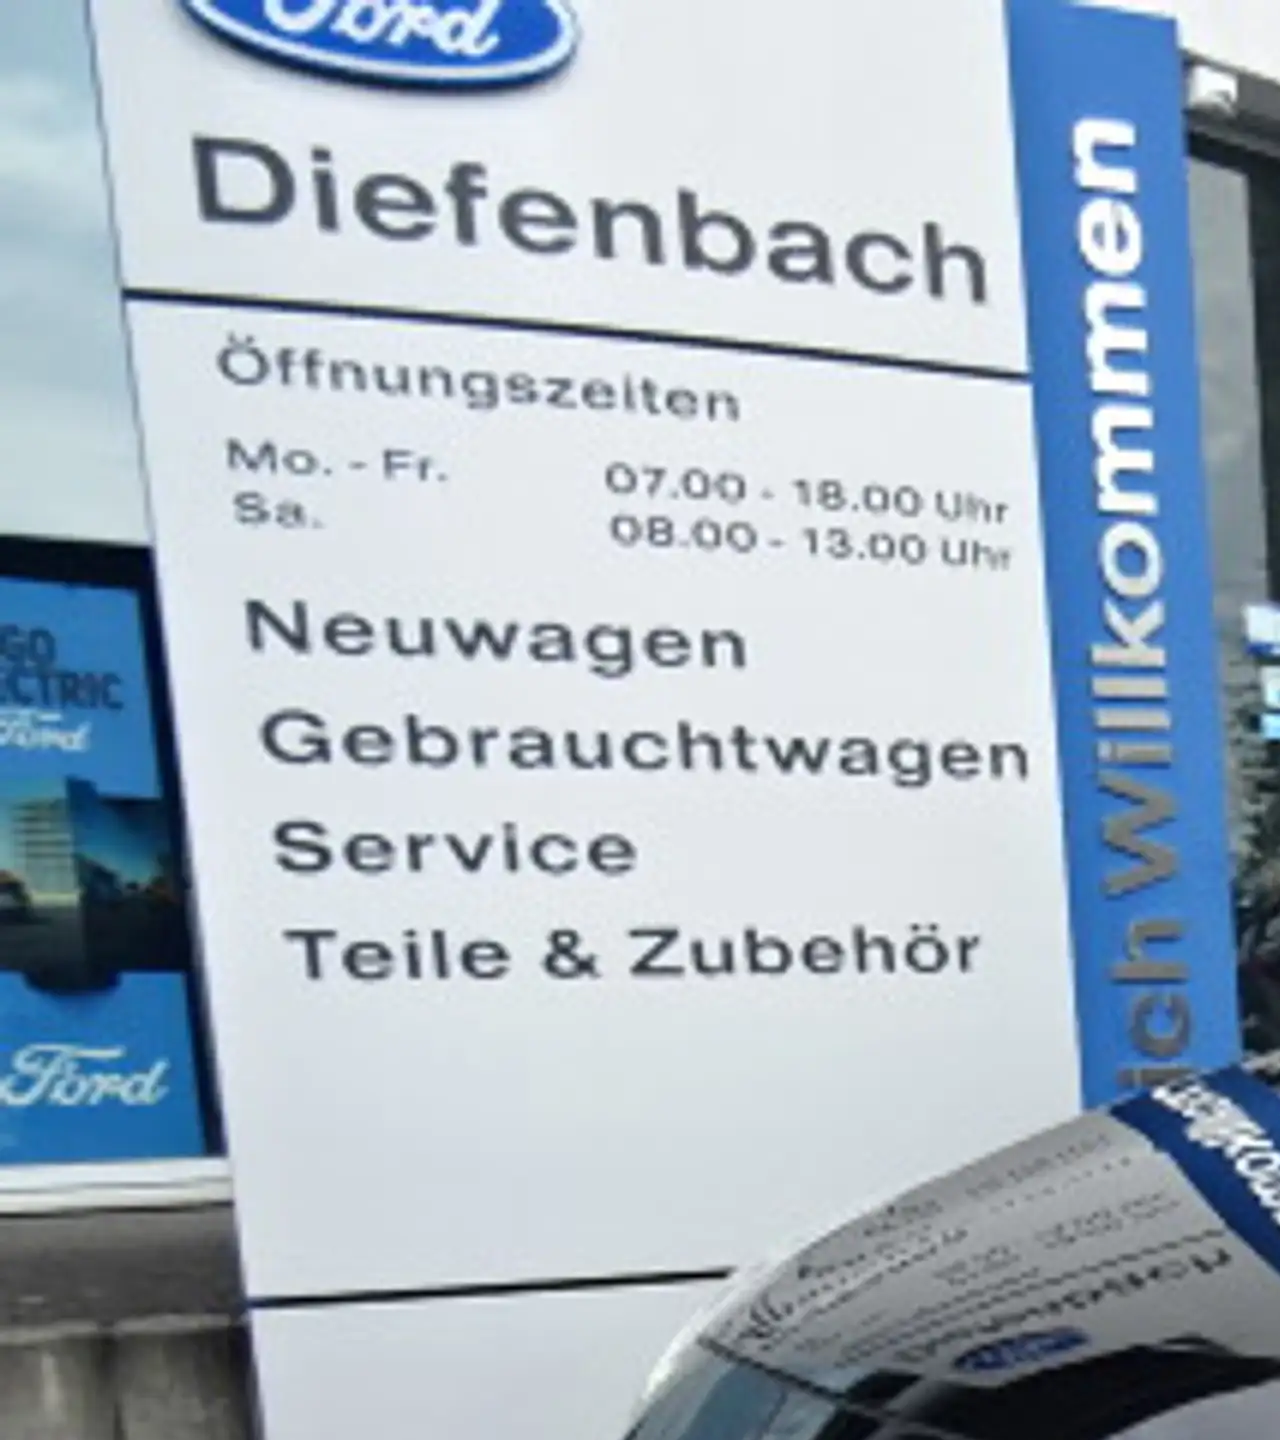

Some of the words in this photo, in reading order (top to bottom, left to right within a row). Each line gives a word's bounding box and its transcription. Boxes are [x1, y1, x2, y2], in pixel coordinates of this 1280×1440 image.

[191, 134, 988, 304] Diefenbach
[217, 332, 741, 422] Öffnungszeiten
[226, 438, 333, 477] Mo.
[381, 447, 449, 485] Fr.
[604, 461, 746, 505] 07.00
[796, 476, 923, 518] 18.00
[934, 488, 1009, 526] Uhr
[233, 491, 325, 531] Sa.
[1071, 116, 1180, 896] Willkommen
[610, 514, 758, 555] 08.00
[804, 525, 928, 566] 13.00
[940, 535, 1013, 572] Uhr
[245, 599, 748, 680] Neuwagen
[258, 707, 1030, 789] Gebrauchtwagen
[273, 818, 638, 875] Service
[283, 928, 512, 982] Teile
[542, 929, 602, 981] &
[628, 924, 981, 977] Zubehör
[0, 1042, 170, 1107] Ford
